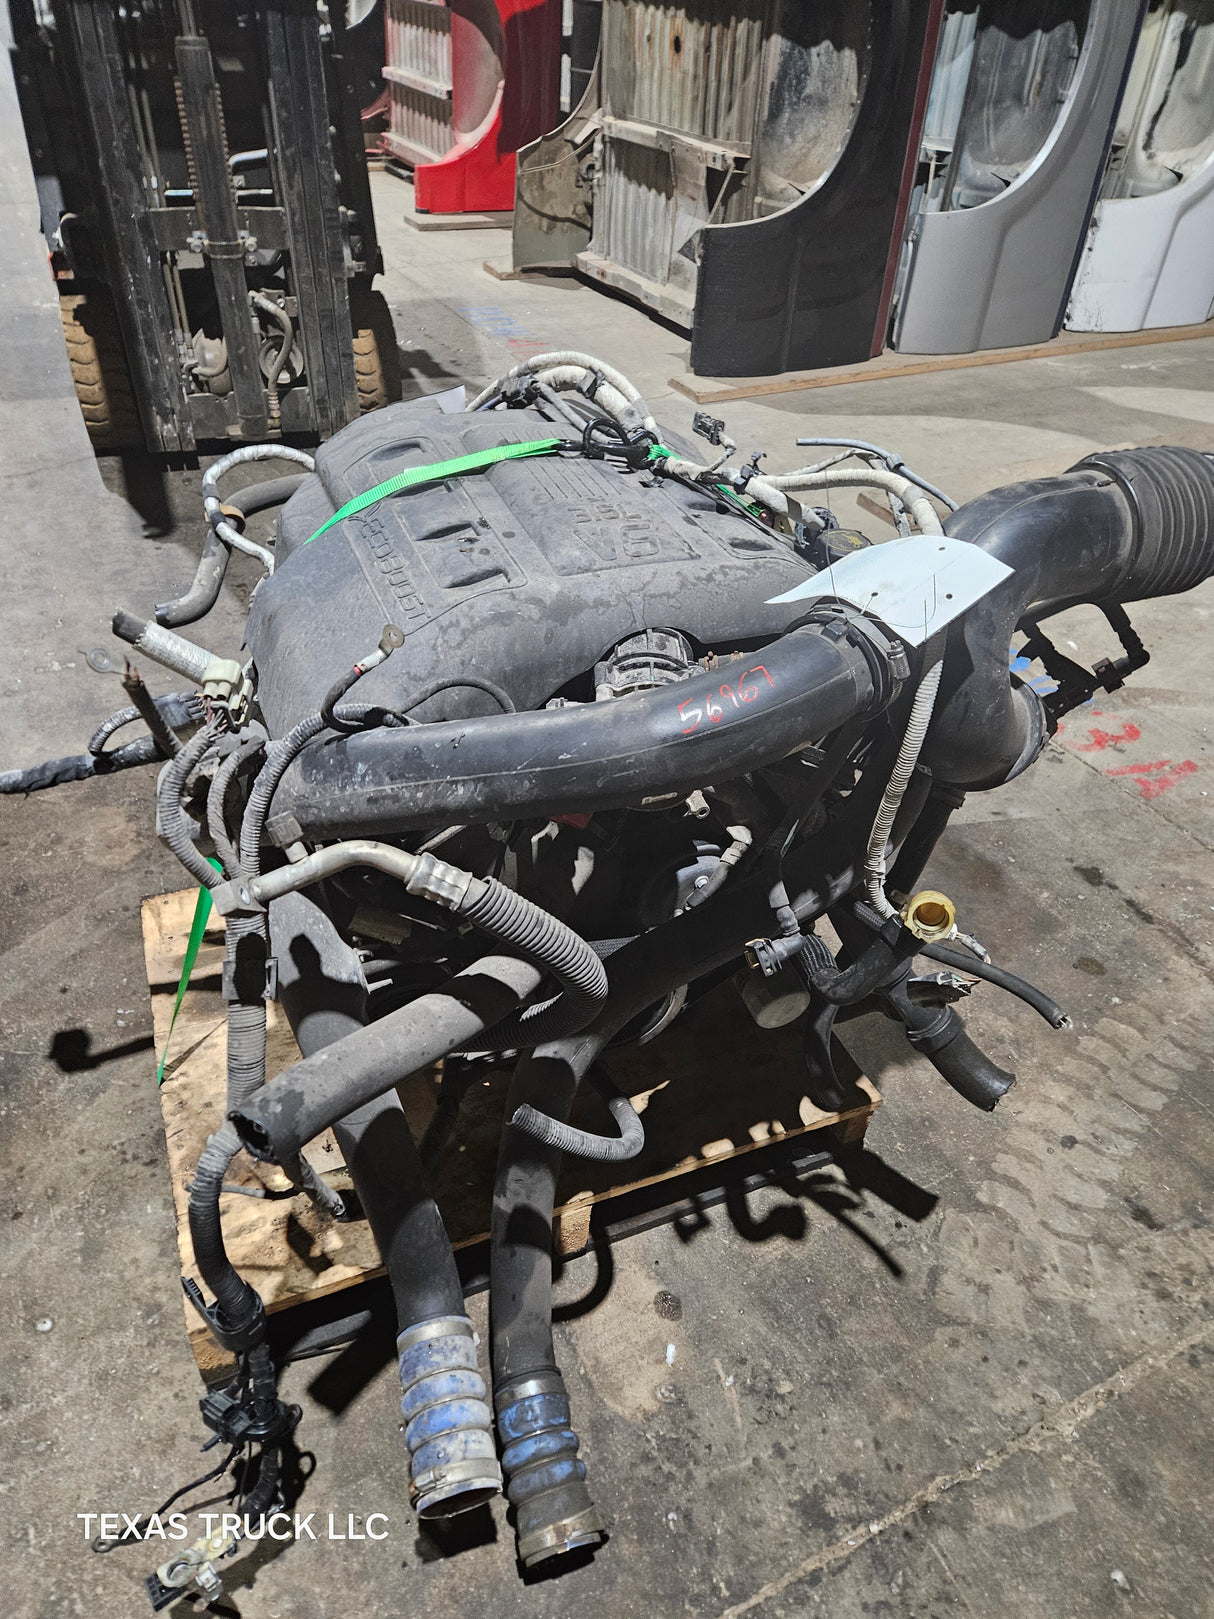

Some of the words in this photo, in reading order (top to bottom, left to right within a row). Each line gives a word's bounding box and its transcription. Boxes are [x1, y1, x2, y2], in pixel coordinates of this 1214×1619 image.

[360, 518, 432, 620] ECOBOOST
[573, 525, 660, 561] V6
[677, 665, 776, 734] 56967
